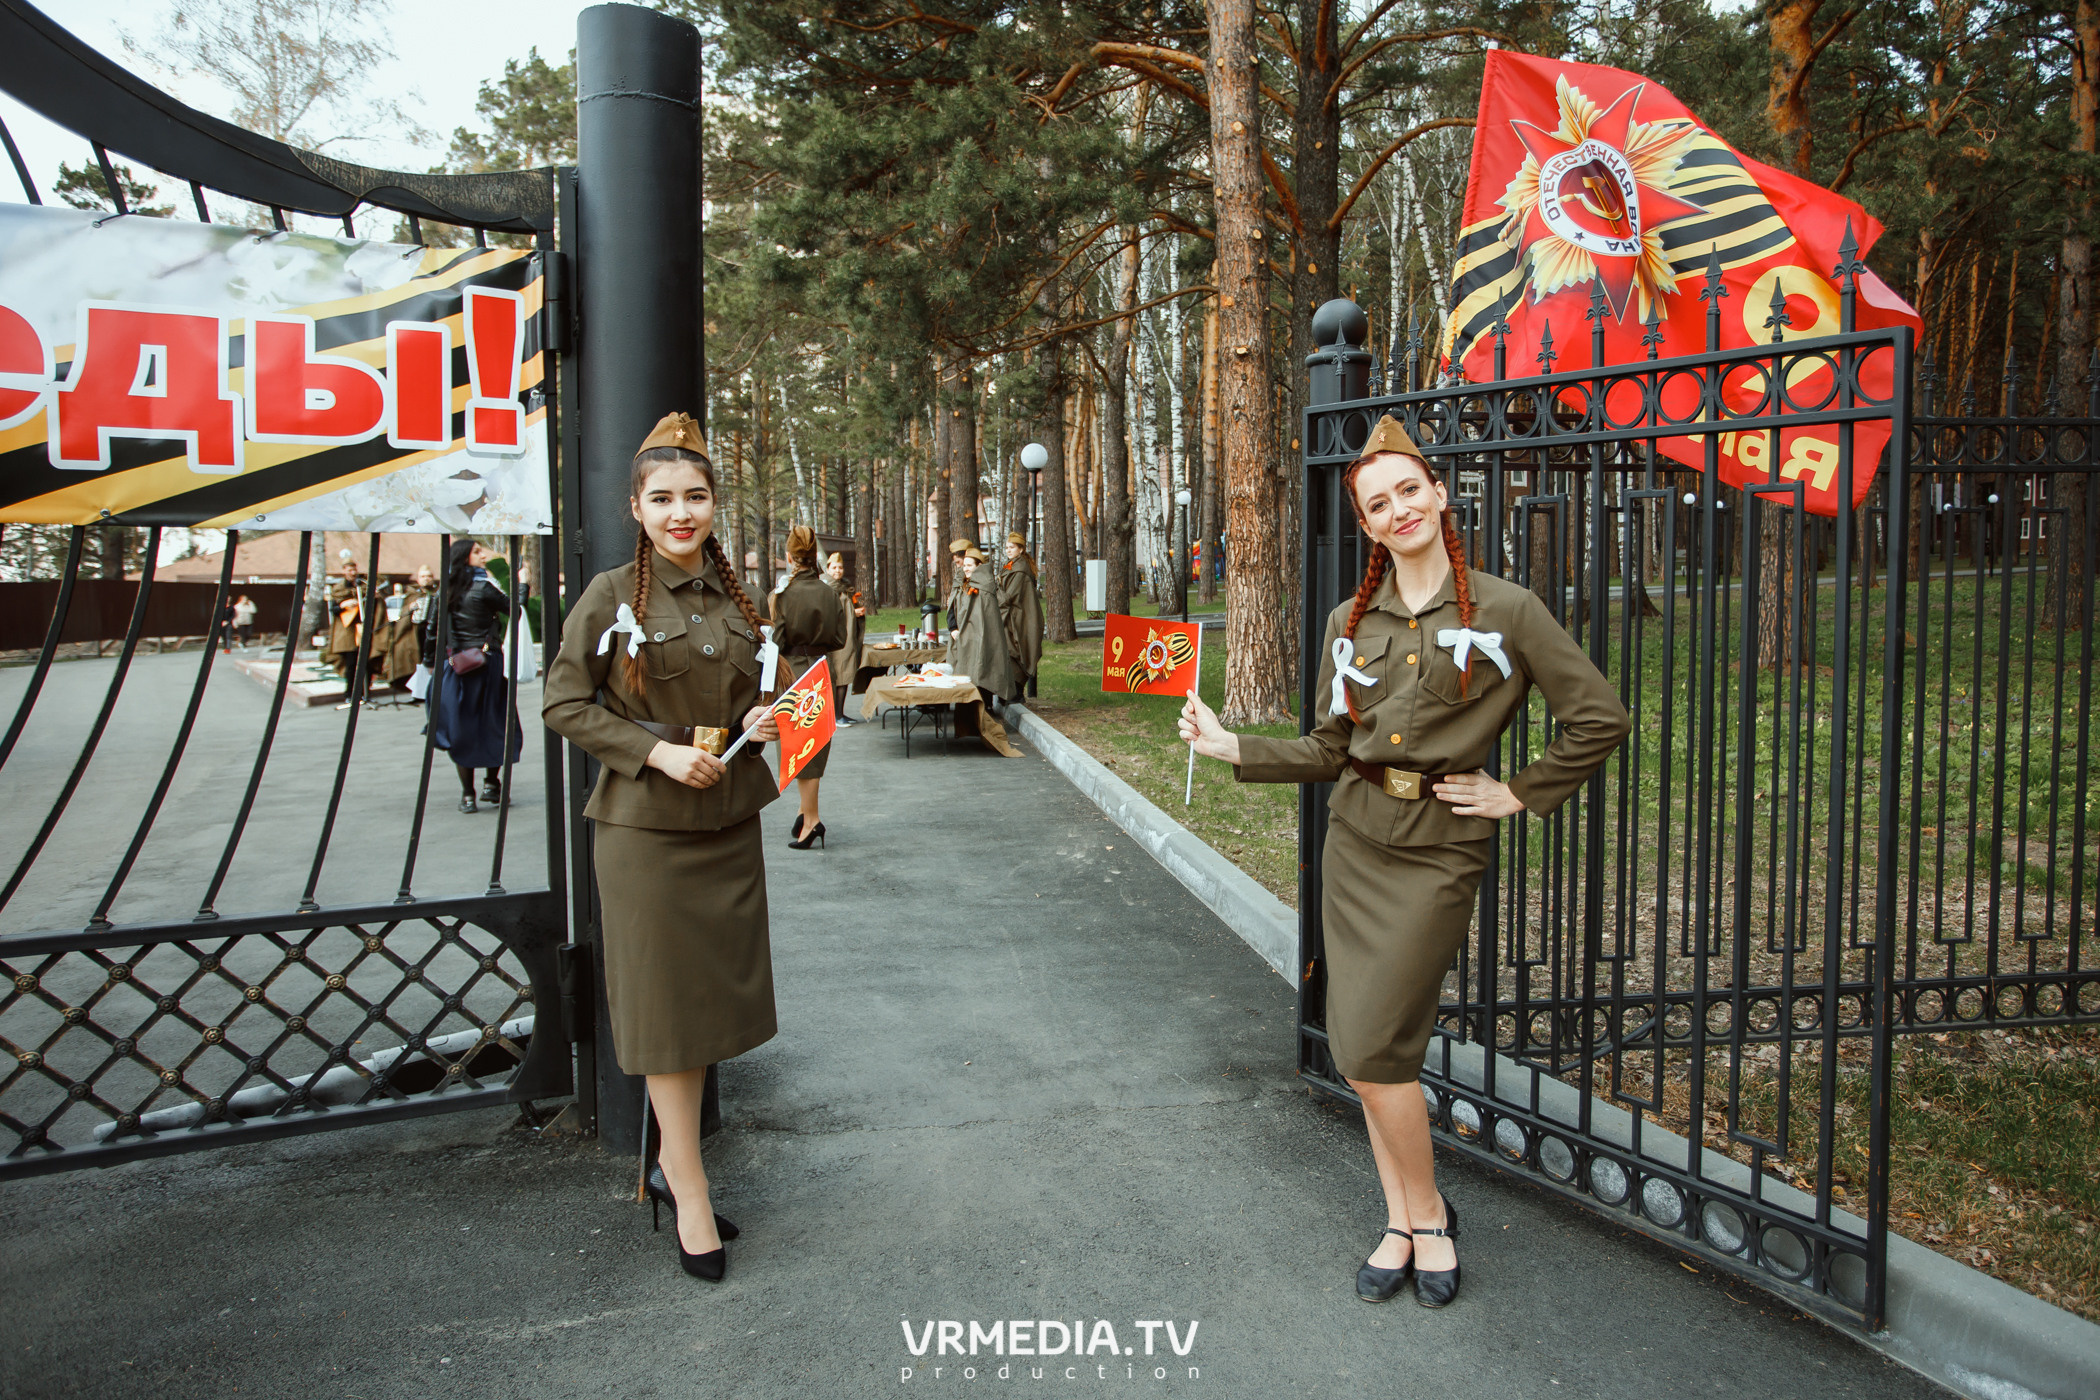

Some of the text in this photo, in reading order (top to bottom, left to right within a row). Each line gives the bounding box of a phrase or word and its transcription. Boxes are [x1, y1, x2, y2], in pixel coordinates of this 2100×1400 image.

[1543, 144, 1634, 222] ОТЕЧЕСТВЕННАЯ
[1741, 265, 1840, 392] 9
[1111, 636, 1124, 663] 9
[1107, 666, 1125, 677] мая
[797, 738, 815, 760] 9
